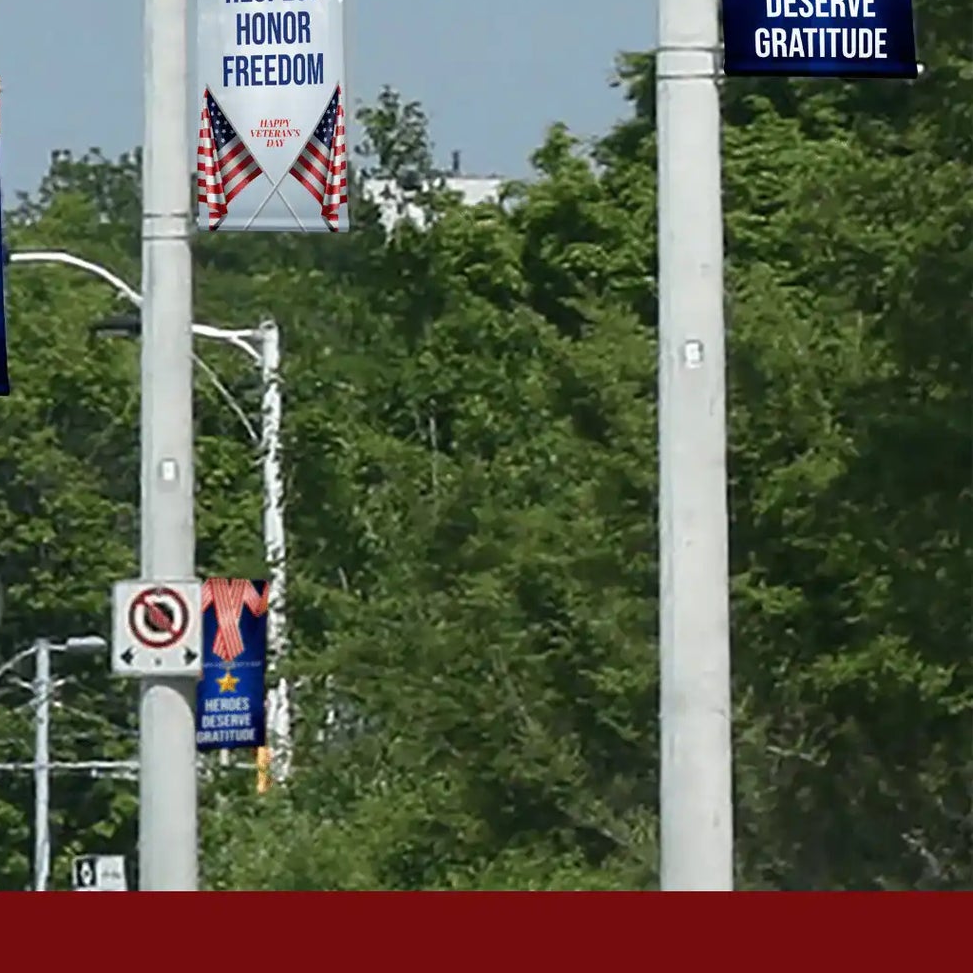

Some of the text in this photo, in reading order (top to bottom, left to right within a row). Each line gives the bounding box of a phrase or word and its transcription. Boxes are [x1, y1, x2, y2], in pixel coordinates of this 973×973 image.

[236, 11, 311, 46] HONOR
[754, 27, 888, 59] GRATITUDE
[223, 53, 324, 87] FREEDOM
[259, 118, 292, 128] HAPPY
[250, 128, 301, 138] VETERAN'S
[266, 138, 286, 147] DAY
[204, 697, 250, 713] HEROES
[201, 713, 252, 729] DESERVE
